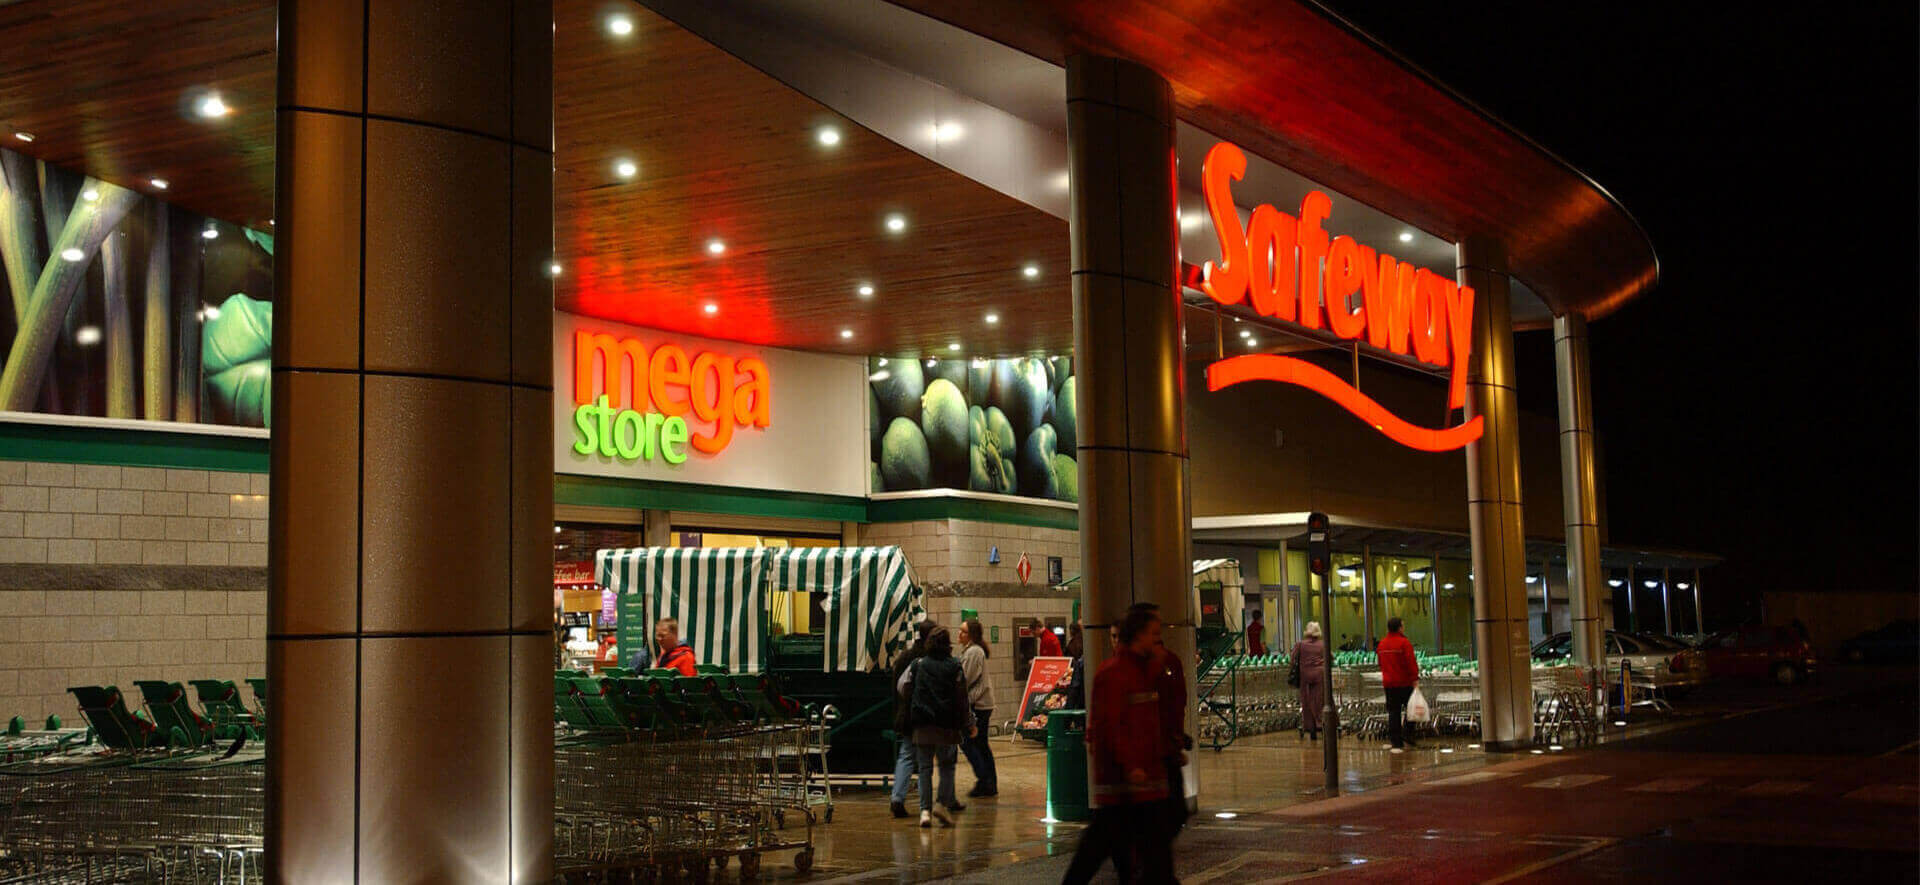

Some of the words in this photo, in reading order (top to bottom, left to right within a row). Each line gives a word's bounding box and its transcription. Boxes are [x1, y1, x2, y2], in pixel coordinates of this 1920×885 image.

[1203, 142, 1475, 408] Safeway
[574, 330, 770, 453] mega
[574, 394, 688, 463] store
